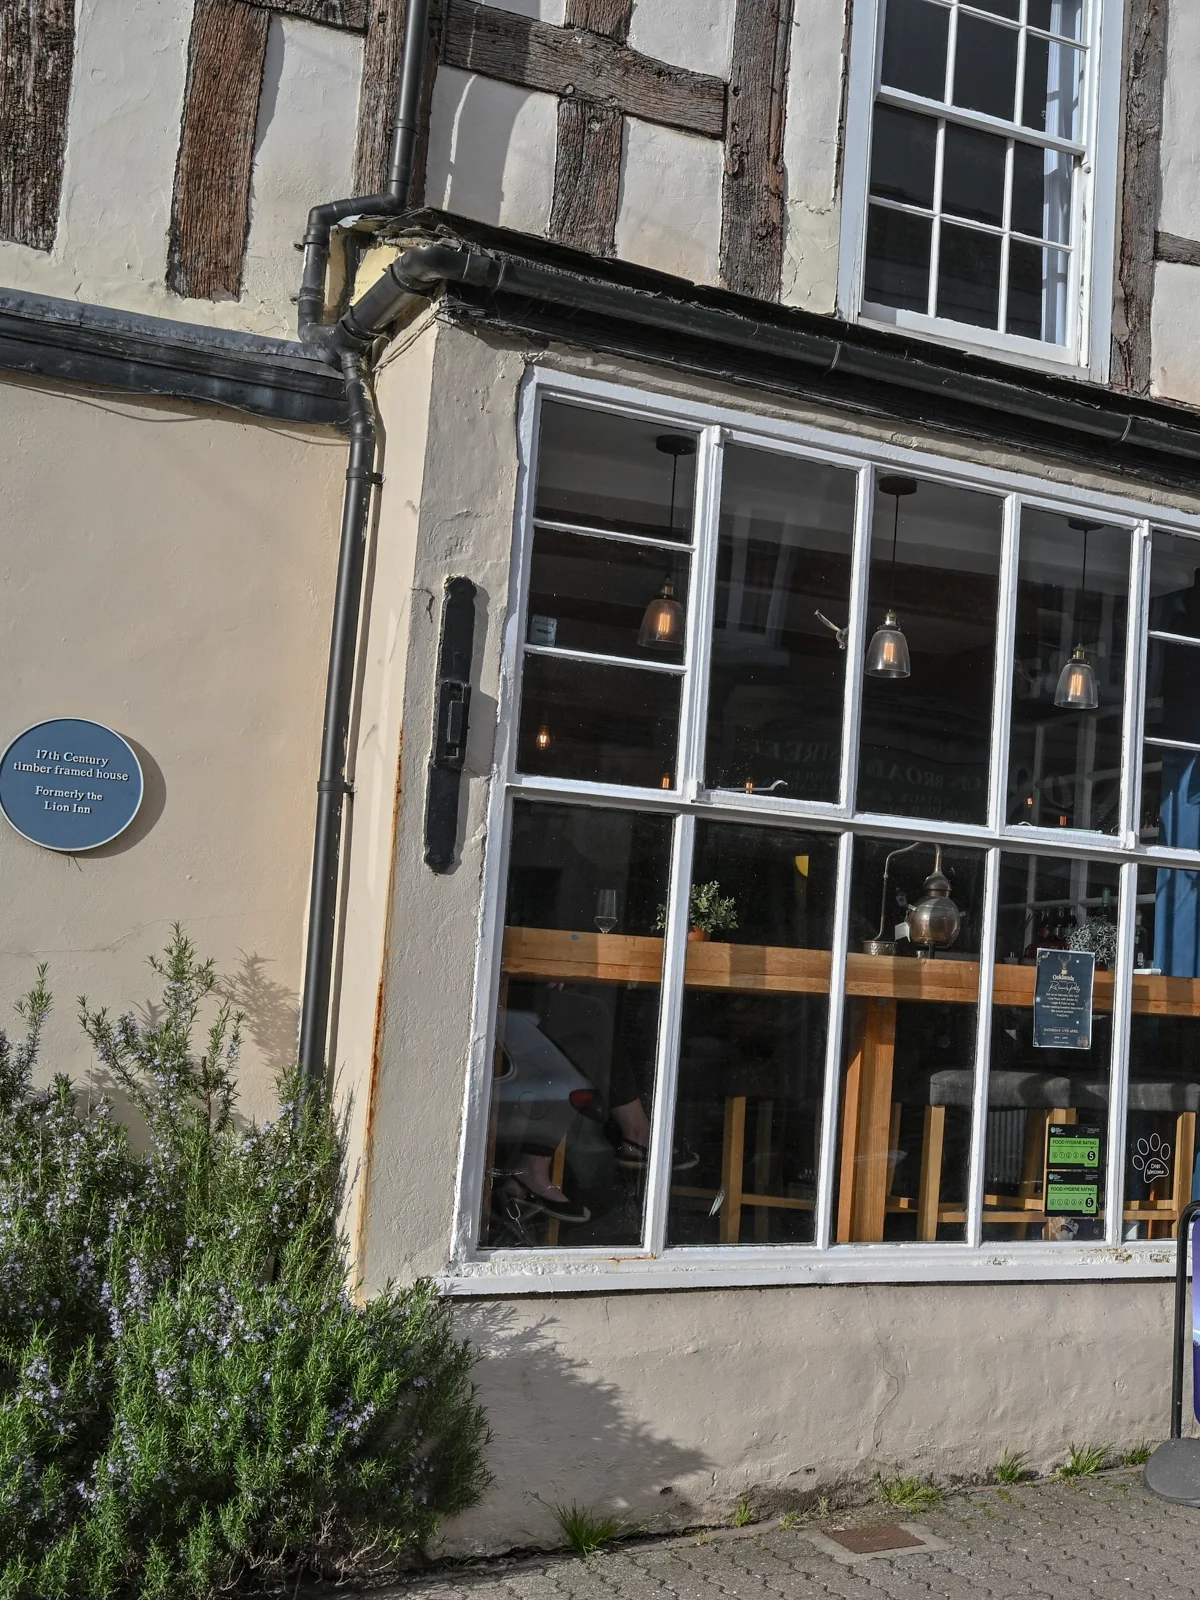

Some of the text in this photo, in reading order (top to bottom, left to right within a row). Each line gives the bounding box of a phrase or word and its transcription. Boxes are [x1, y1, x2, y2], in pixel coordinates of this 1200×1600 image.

[36, 750, 109, 767] 17th Century
[13, 762, 129, 781] timber framed house
[35, 786, 103, 801] Formerly the
[44, 801, 91, 814] Lion Inn
